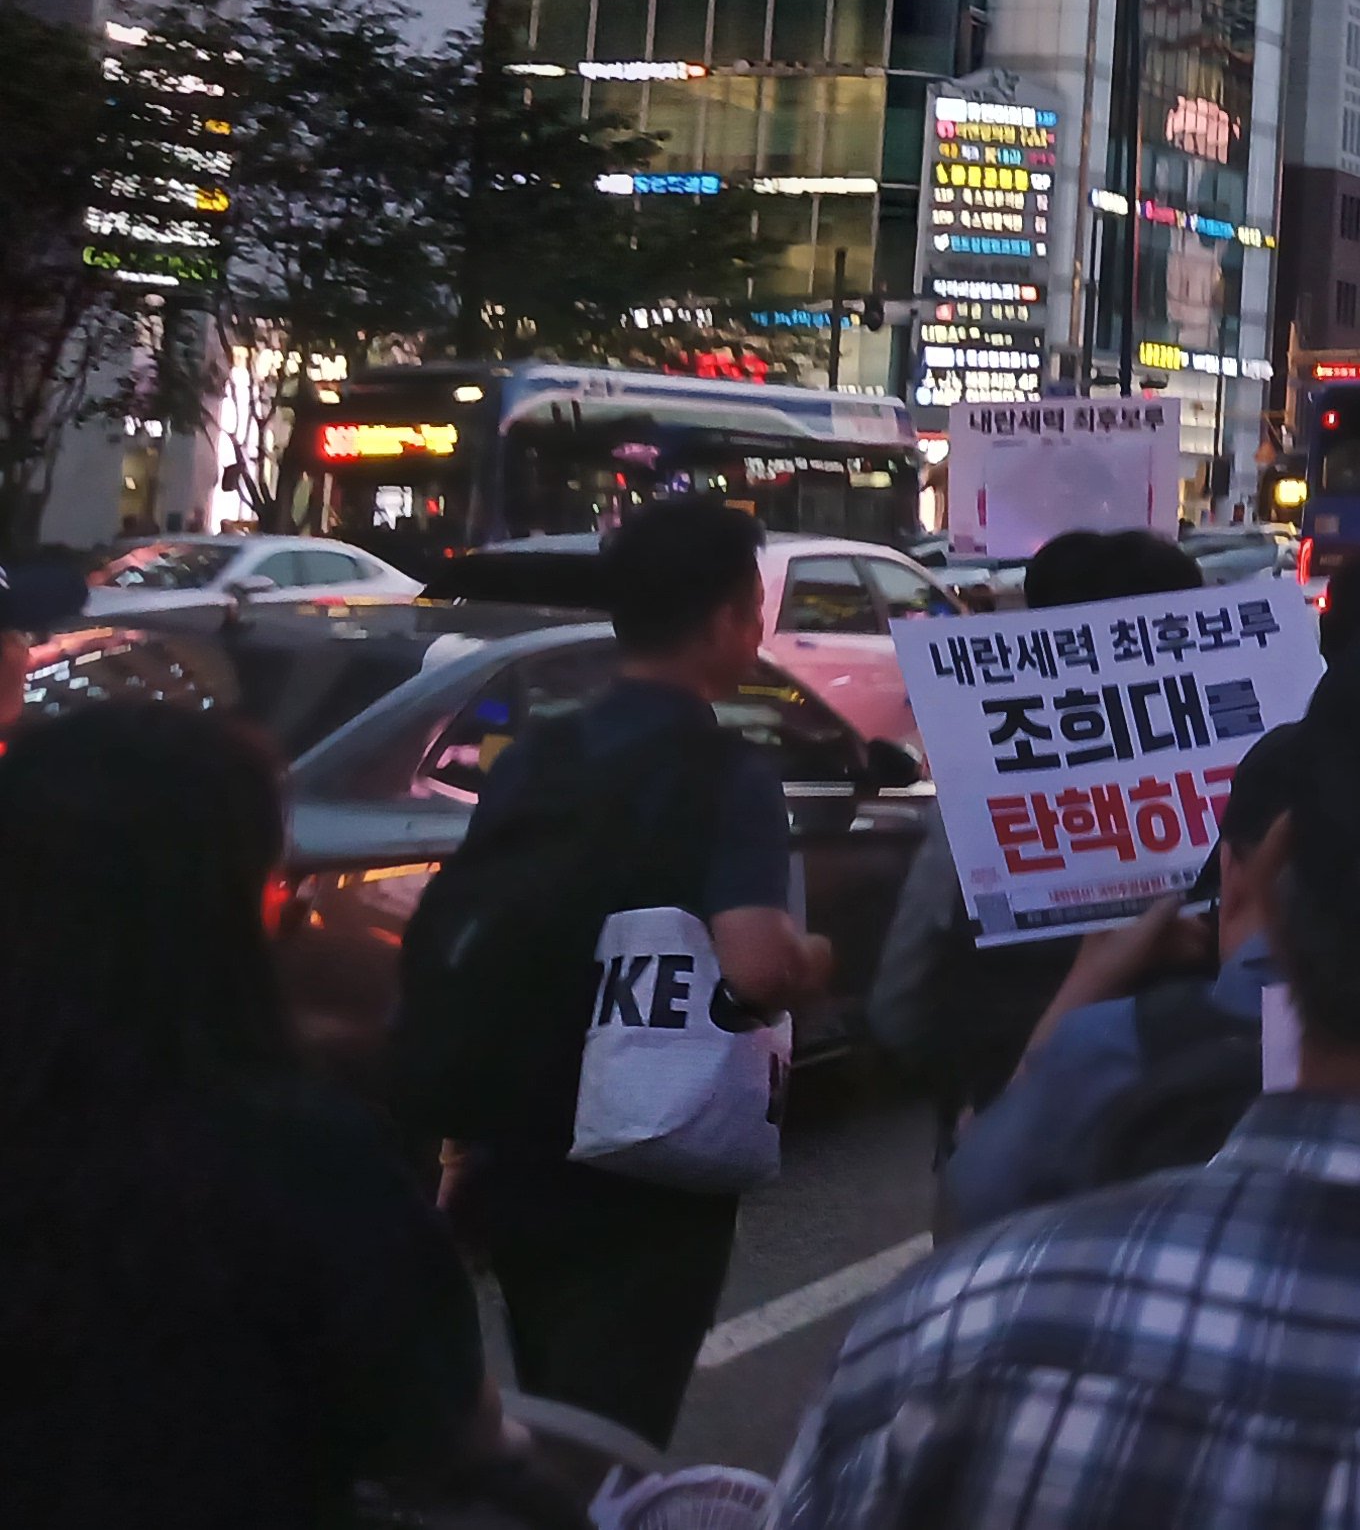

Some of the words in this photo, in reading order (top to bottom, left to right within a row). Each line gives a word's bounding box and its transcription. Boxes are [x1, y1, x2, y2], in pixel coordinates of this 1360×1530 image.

[967, 406, 1066, 436] 내란세력
[928, 622, 1102, 688] 내란세력
[1109, 599, 1281, 667] 최후보루
[982, 673, 1265, 775] 조희대를
[592, 953, 695, 1030] KE
